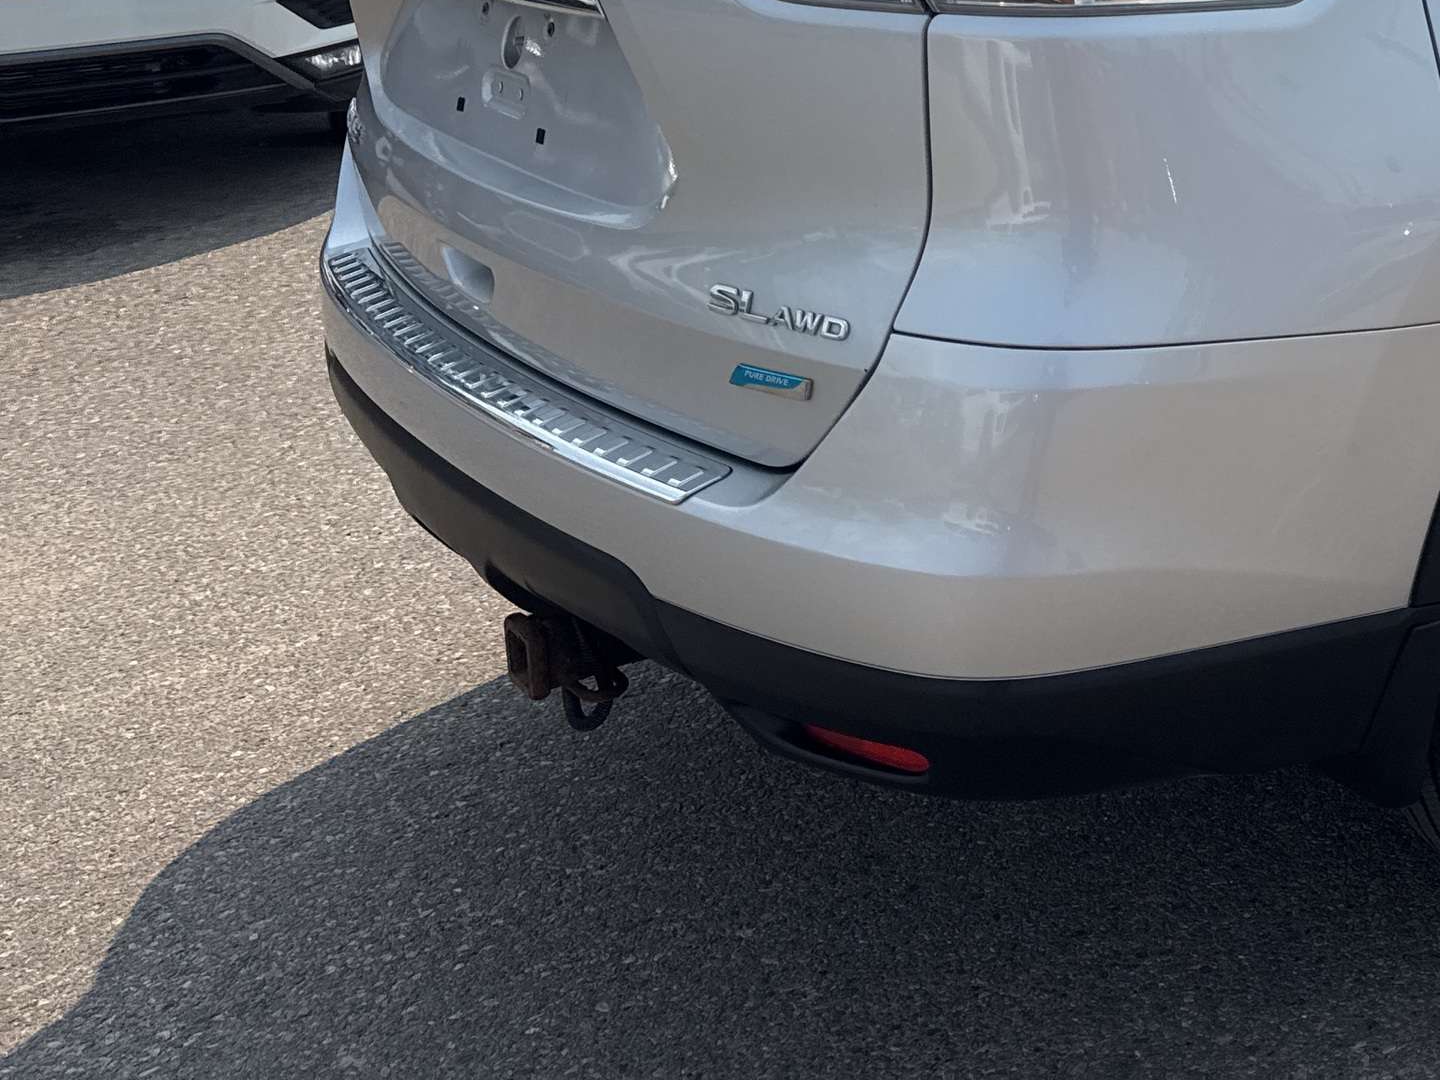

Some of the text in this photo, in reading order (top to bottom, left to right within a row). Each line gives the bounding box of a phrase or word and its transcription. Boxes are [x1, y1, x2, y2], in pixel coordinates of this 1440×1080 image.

[706, 283, 850, 341] SL AWD
[744, 370, 789, 386] PURE DRIVE
